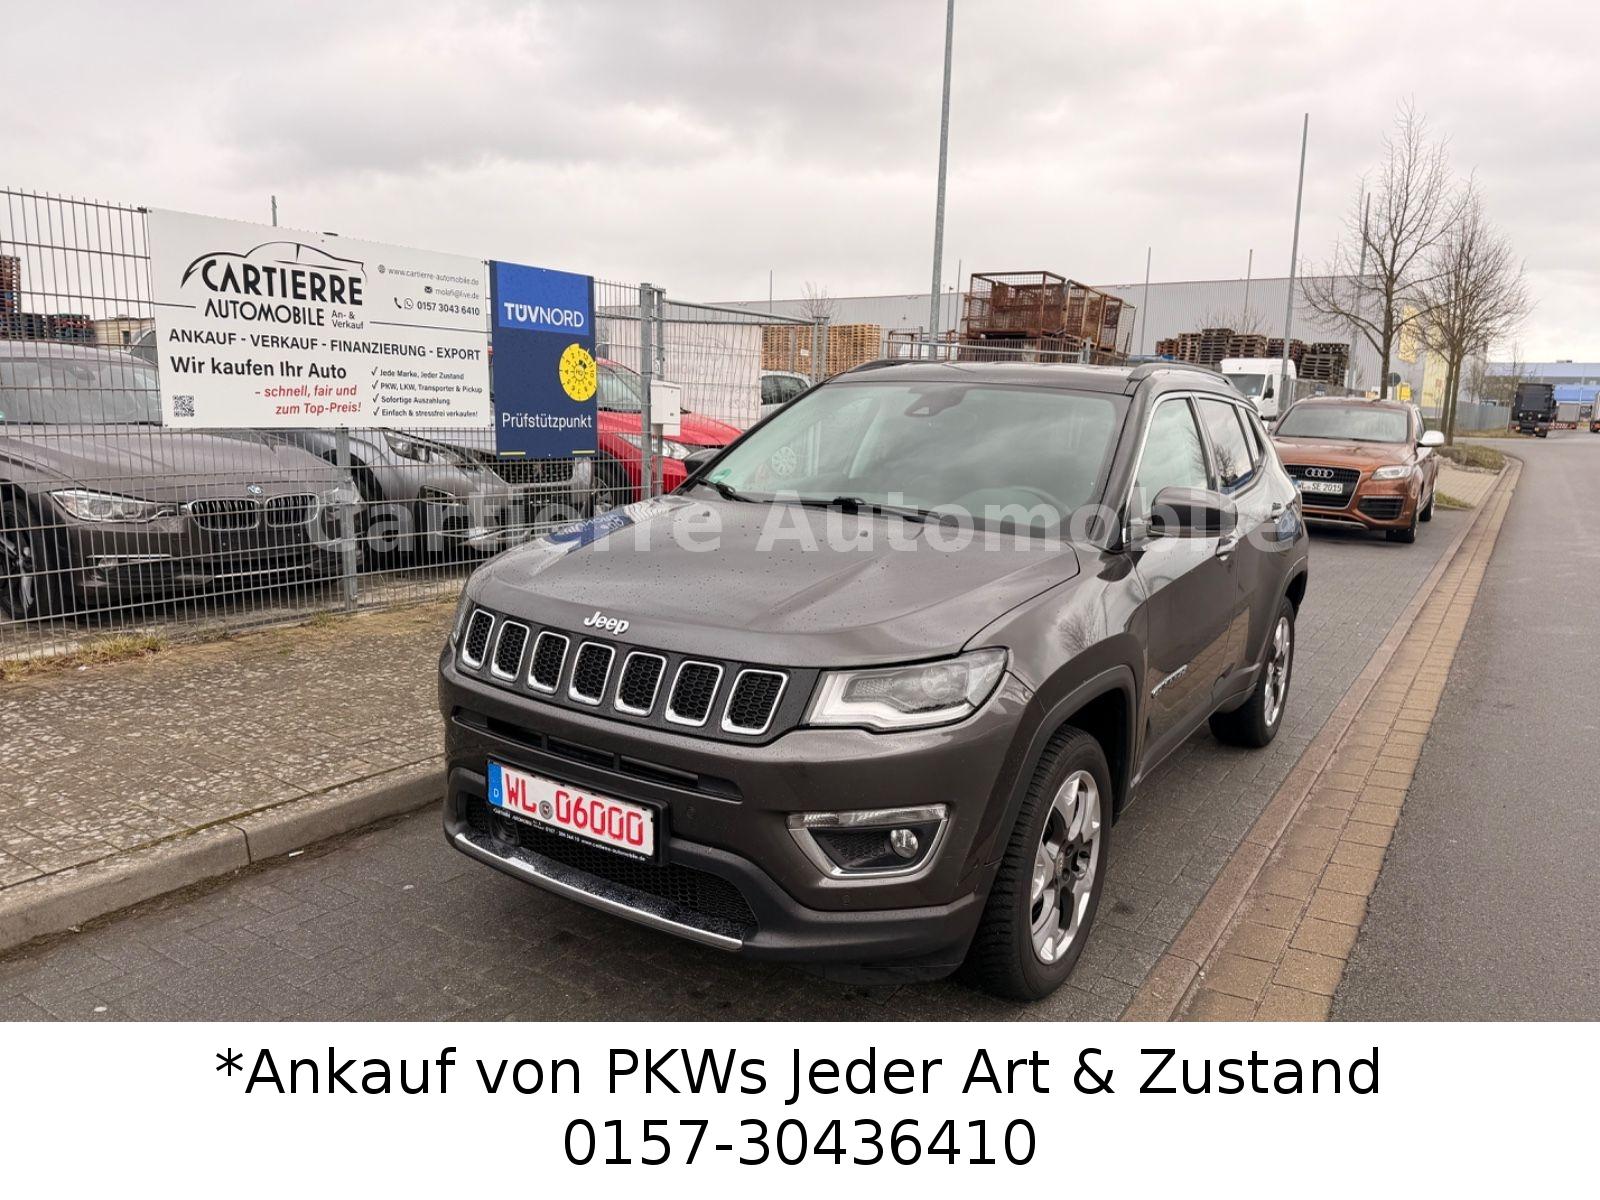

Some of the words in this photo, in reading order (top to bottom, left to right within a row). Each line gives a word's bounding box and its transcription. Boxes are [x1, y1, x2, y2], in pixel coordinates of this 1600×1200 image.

[202, 259, 363, 306] CARTIERRE
[388, 267, 479, 286] www.cartierre-automobile.de
[204, 298, 325, 327] AUTOMOBILE
[332, 310, 347, 319] An-
[349, 311, 356, 320] &
[417, 300, 437, 311] 0157
[438, 302, 459, 314] 3043
[461, 305, 480, 316] 6410
[332, 319, 364, 330] Verkauf
[169, 328, 237, 345] ANKAUF
[250, 333, 318, 351] VERKAUF
[331, 340, 426, 357] FINANZIERUNG
[436, 347, 481, 361] EXPORT
[171, 356, 205, 374] Wir
[211, 357, 275, 377] kaufen
[280, 360, 301, 378] Ihr
[308, 362, 347, 380] Auto
[380, 369, 395, 377] Jede
[439, 372, 464, 380] Zustand
[264, 384, 311, 399] schnell,
[314, 384, 336, 398] fair
[338, 384, 357, 397] und
[380, 382, 399, 391] PKW,
[400, 383, 417, 391] LKW,
[418, 384, 454, 393] Transporter
[463, 386, 482, 394] Pickup
[381, 395, 411, 404] Sofortige
[414, 396, 450, 406] Auszahlung
[276, 402, 300, 415] zum
[303, 401, 361, 417] Top-Preis!
[382, 409, 407, 417] Einfach
[415, 409, 445, 417] stressfrei
[502, 412, 592, 431] Prüfstützpunkt
[583, 611, 630, 635] Jeep
[493, 788, 500, 798] D
[505, 773, 537, 813] WL
[555, 790, 644, 846] 06000
